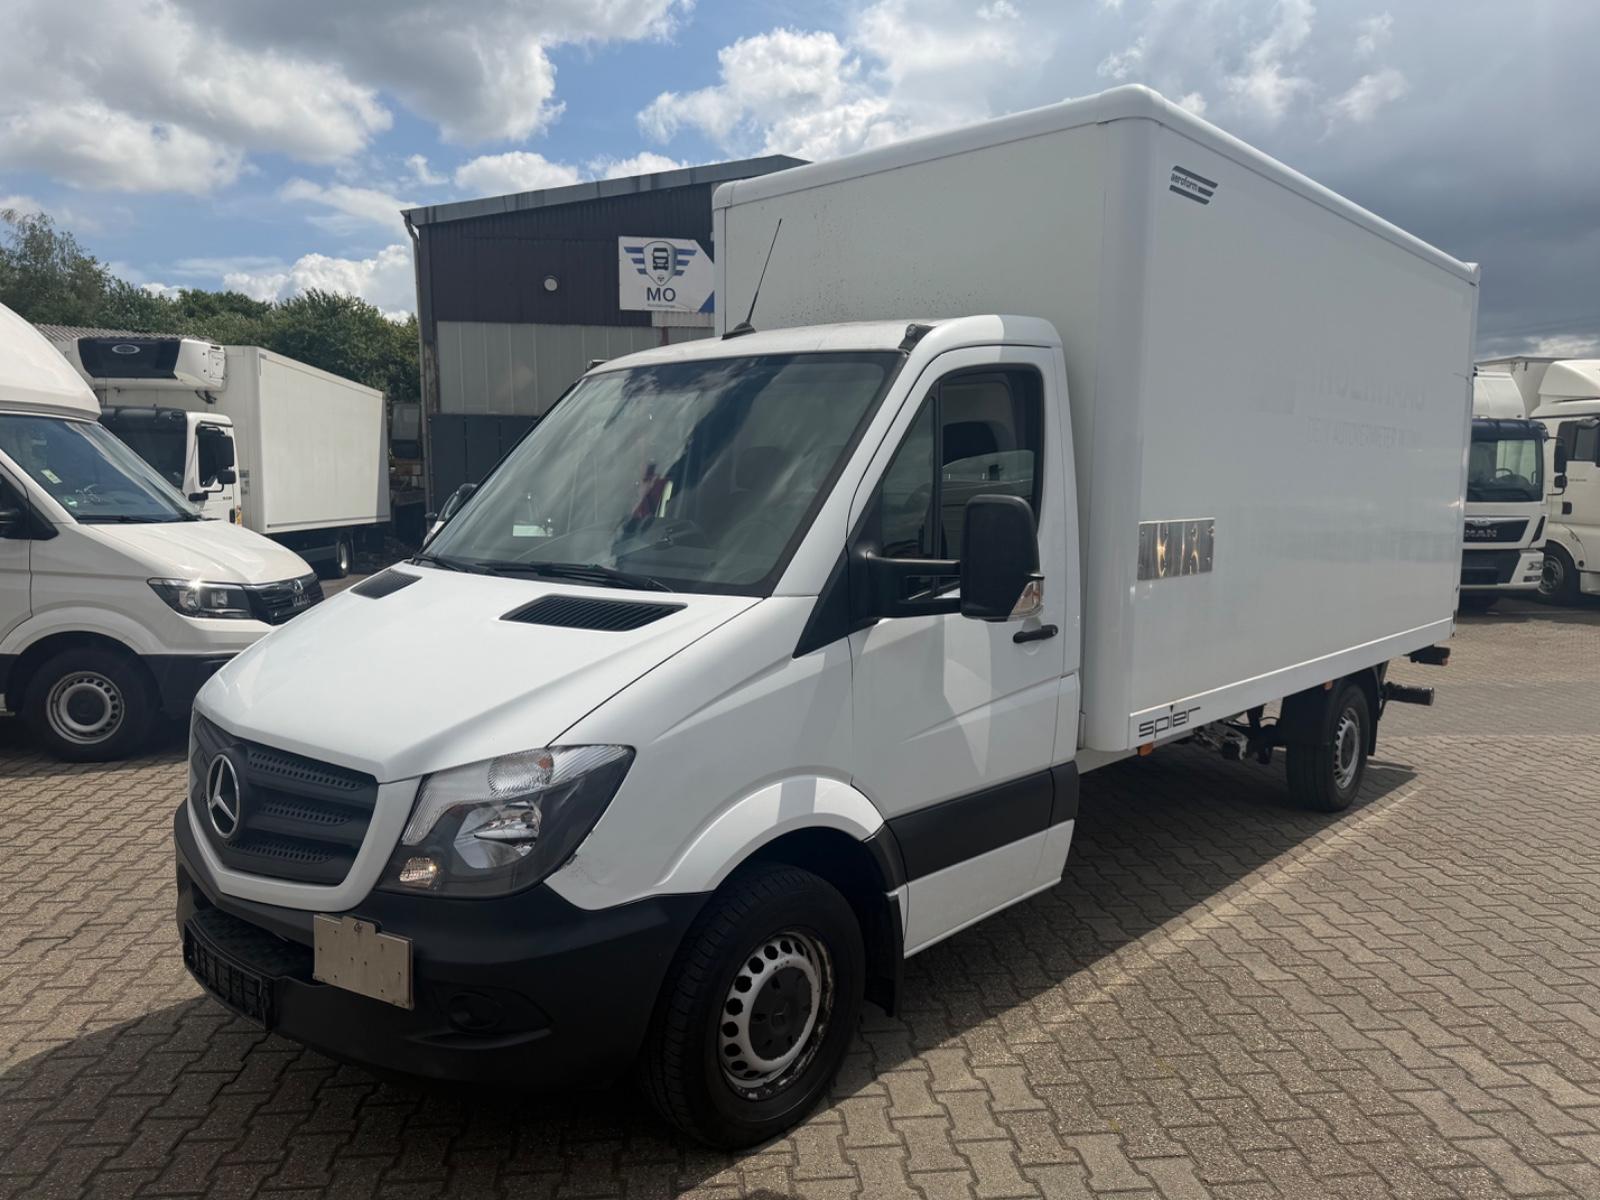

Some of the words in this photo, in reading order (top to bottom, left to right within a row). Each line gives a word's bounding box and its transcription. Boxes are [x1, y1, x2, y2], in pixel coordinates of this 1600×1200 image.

[647, 287, 676, 302] MO
[1465, 529, 1497, 537] MAN
[1138, 704, 1201, 739] spier
